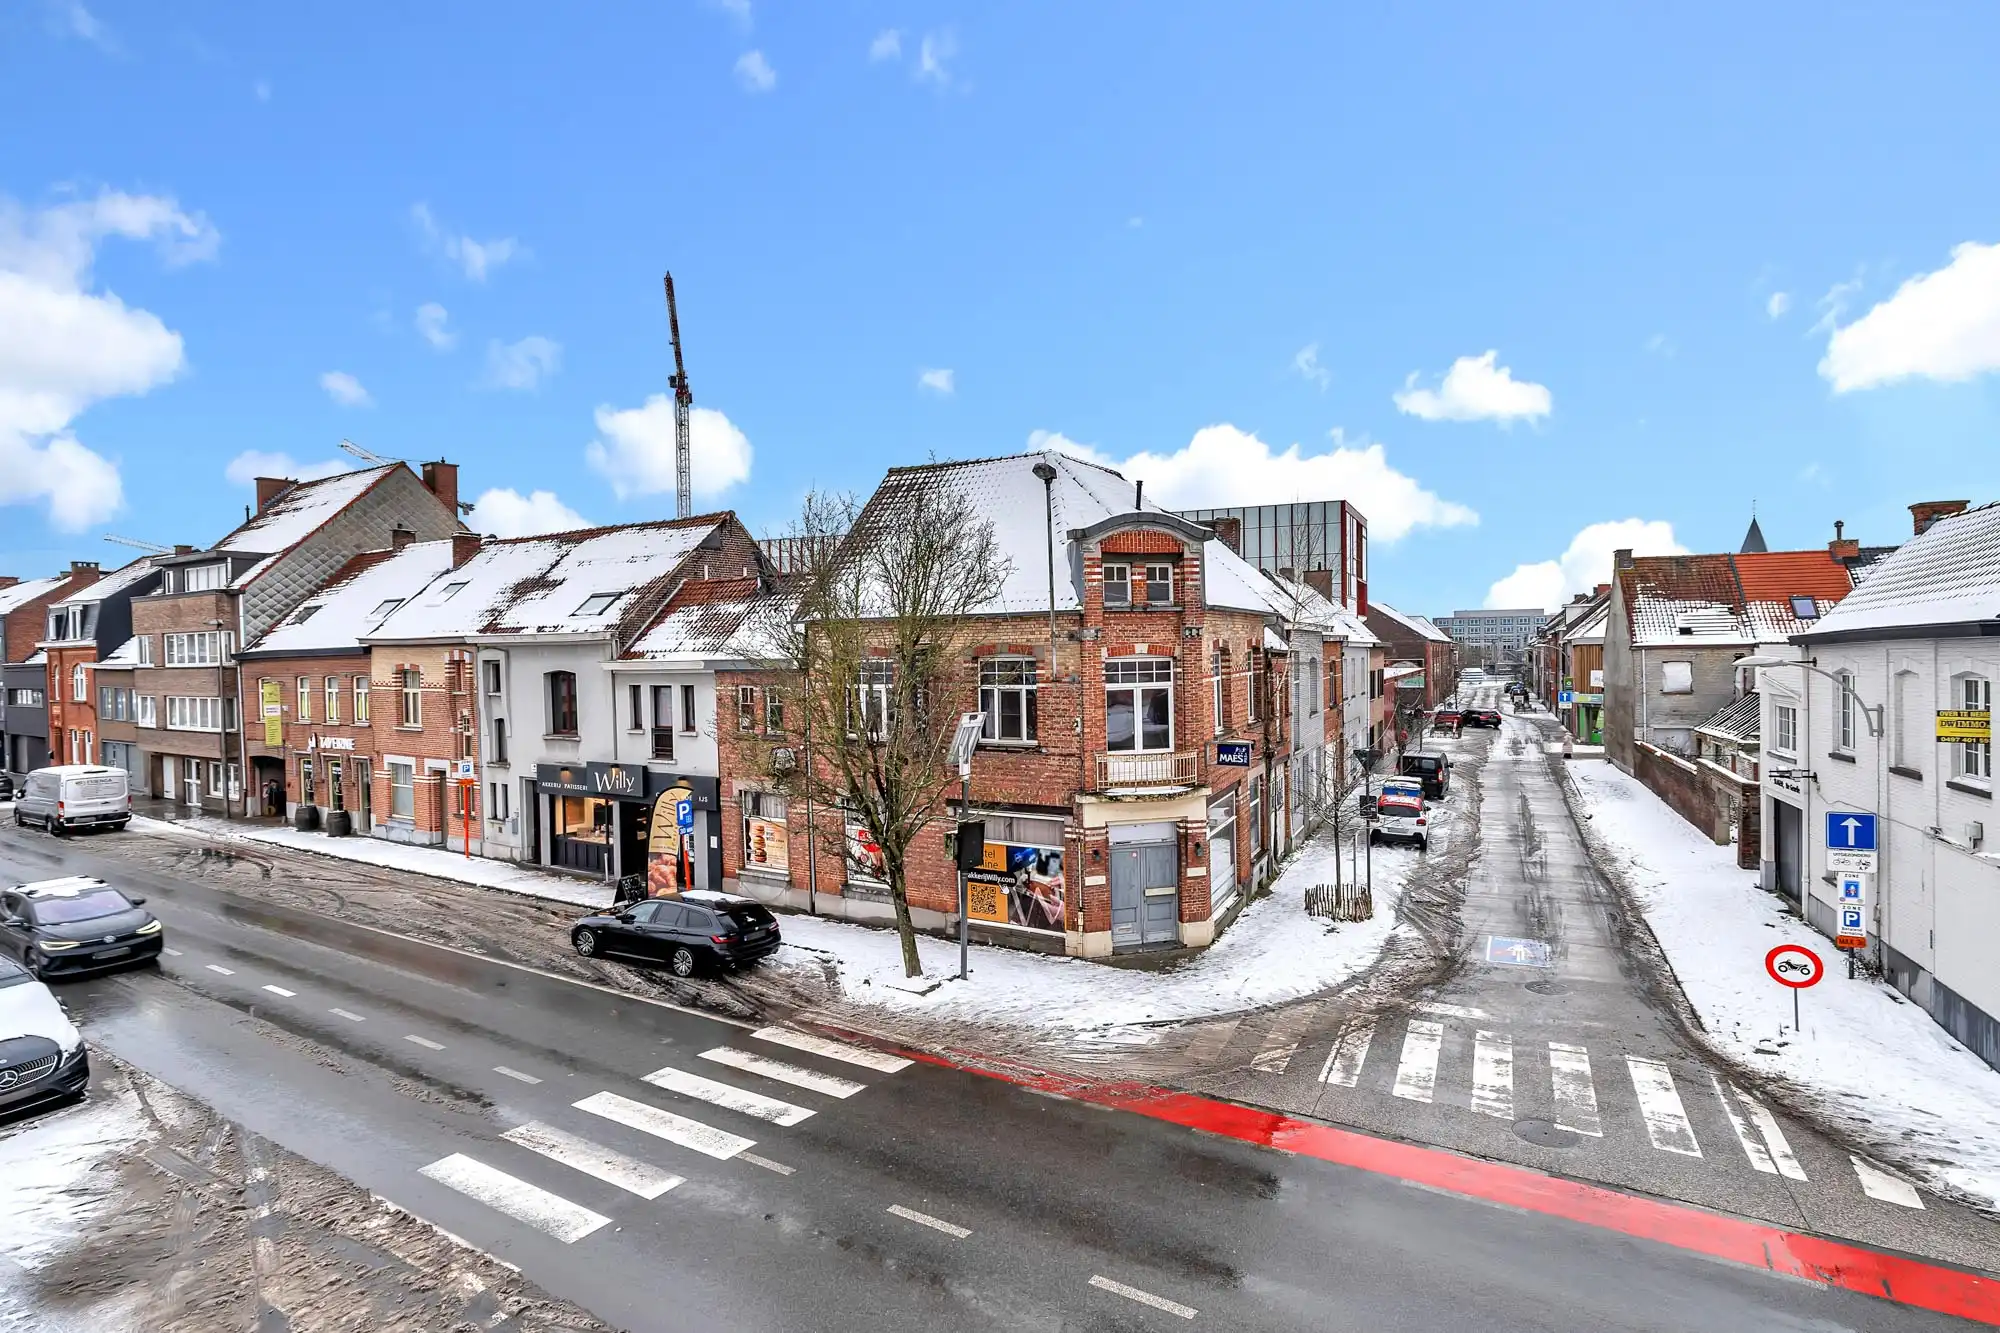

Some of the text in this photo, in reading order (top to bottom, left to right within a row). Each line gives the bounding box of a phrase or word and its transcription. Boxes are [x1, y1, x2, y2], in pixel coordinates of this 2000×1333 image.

[1219, 753, 1243, 763] MAES
[541, 781, 588, 791] AKKERIJ PATISSERI
[594, 771, 635, 792] Willy
[679, 803, 689, 820] P
[967, 872, 1015, 883] akkerijWilly.com
[1845, 912, 1858, 926] P
